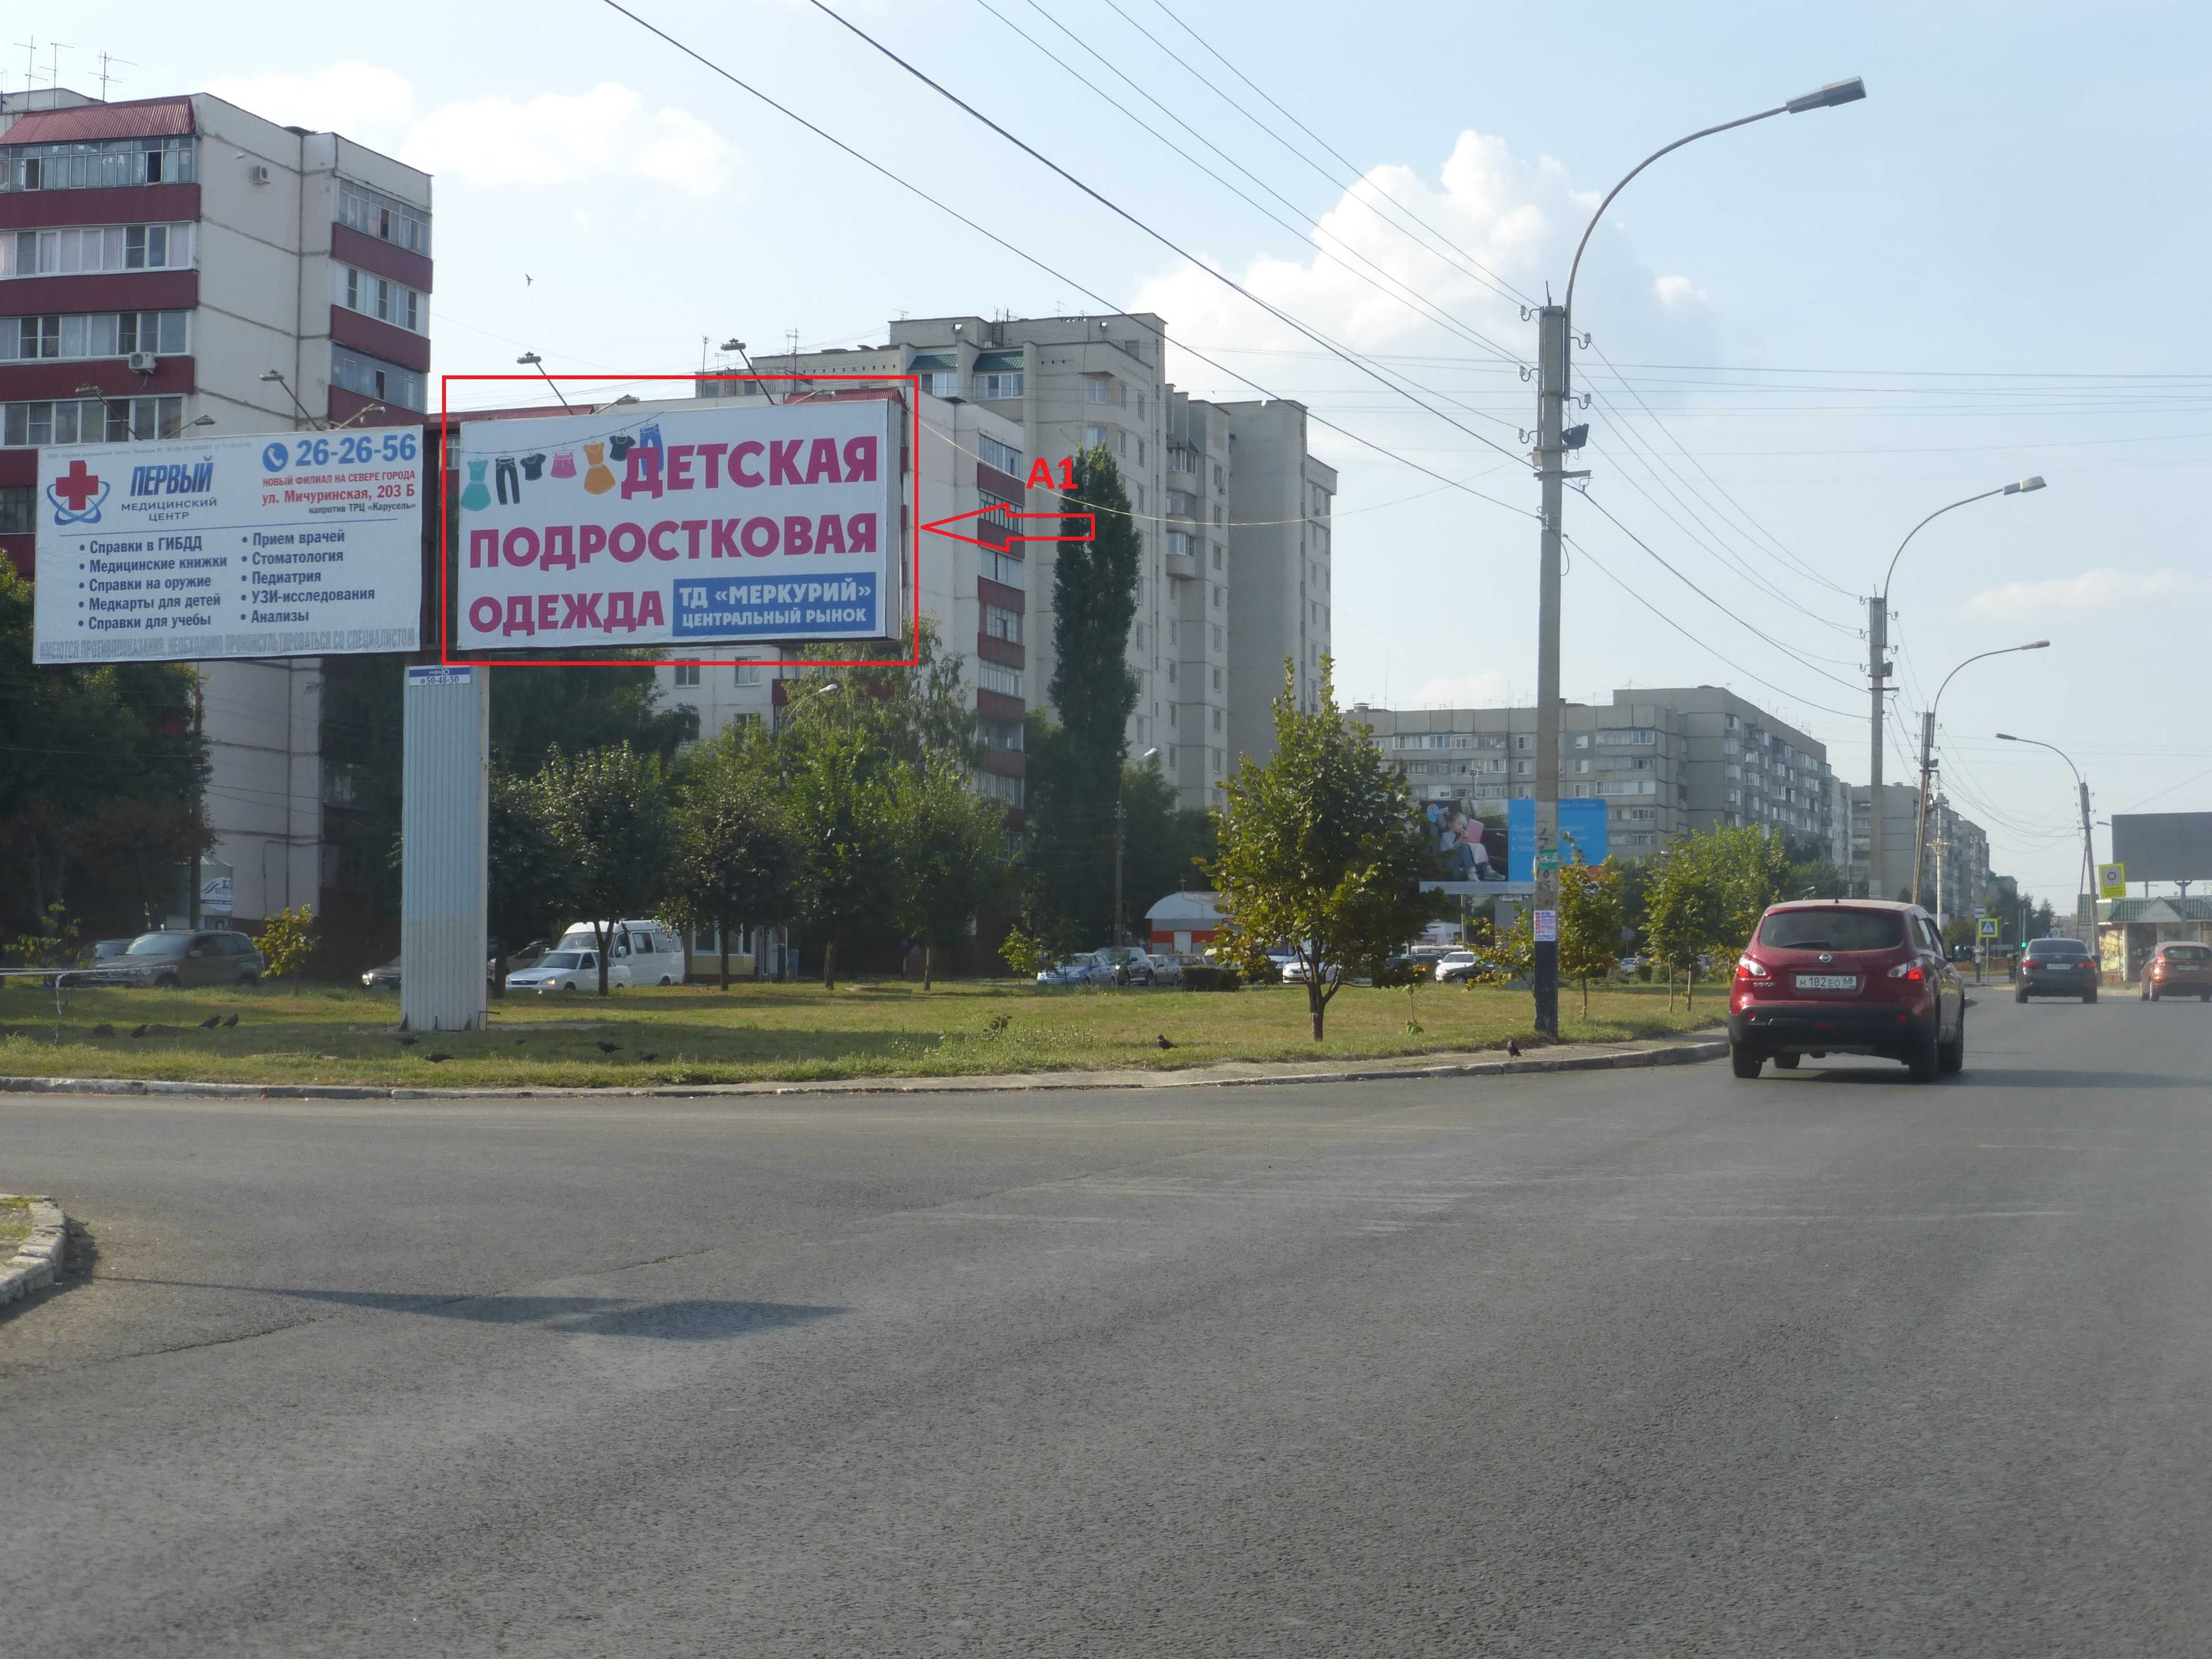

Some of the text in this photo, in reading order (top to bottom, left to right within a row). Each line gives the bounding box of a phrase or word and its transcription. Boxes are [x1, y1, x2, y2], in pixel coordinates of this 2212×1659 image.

[296, 434, 416, 467] 26-26-56
[130, 455, 213, 497] ПЕРВЫЙ
[621, 436, 877, 500] ДЕТСКАЯ
[263, 470, 415, 487] НОВЫЙ ФИЛИАЛ НА СЕВЕРЕ ГОРОДА
[262, 484, 415, 506] ул. Мичуринская, 203 Б
[121, 498, 217, 512] МЕДИЦИНСКИЙ
[309, 502, 416, 514] напротив ТРЦ «Карусель»
[149, 512, 190, 522] ЦЕНТР
[90, 536, 202, 555] Справки в ГИБДД
[253, 529, 345, 548] Прием врачей
[470, 513, 877, 572] ПОДРОСТКОВАЯ
[90, 557, 227, 574] Медицинские книжки
[252, 551, 344, 565] Стоматология
[89, 576, 211, 593] Справки на оружие
[252, 571, 321, 585] Педиатрия
[89, 593, 221, 612] Медкарты для детей
[252, 589, 375, 604] УЗИ-исследования
[679, 577, 871, 609] ТД «МЕРКУРИЙ»
[89, 612, 211, 631] Справки для учебы
[251, 609, 309, 623] Анализы
[469, 590, 664, 638] ОДЕЖДА
[683, 607, 866, 628] ЦЕНТРАЛЬНЫЙ РЫНОК
[426, 676, 459, 684] 50-48-50
